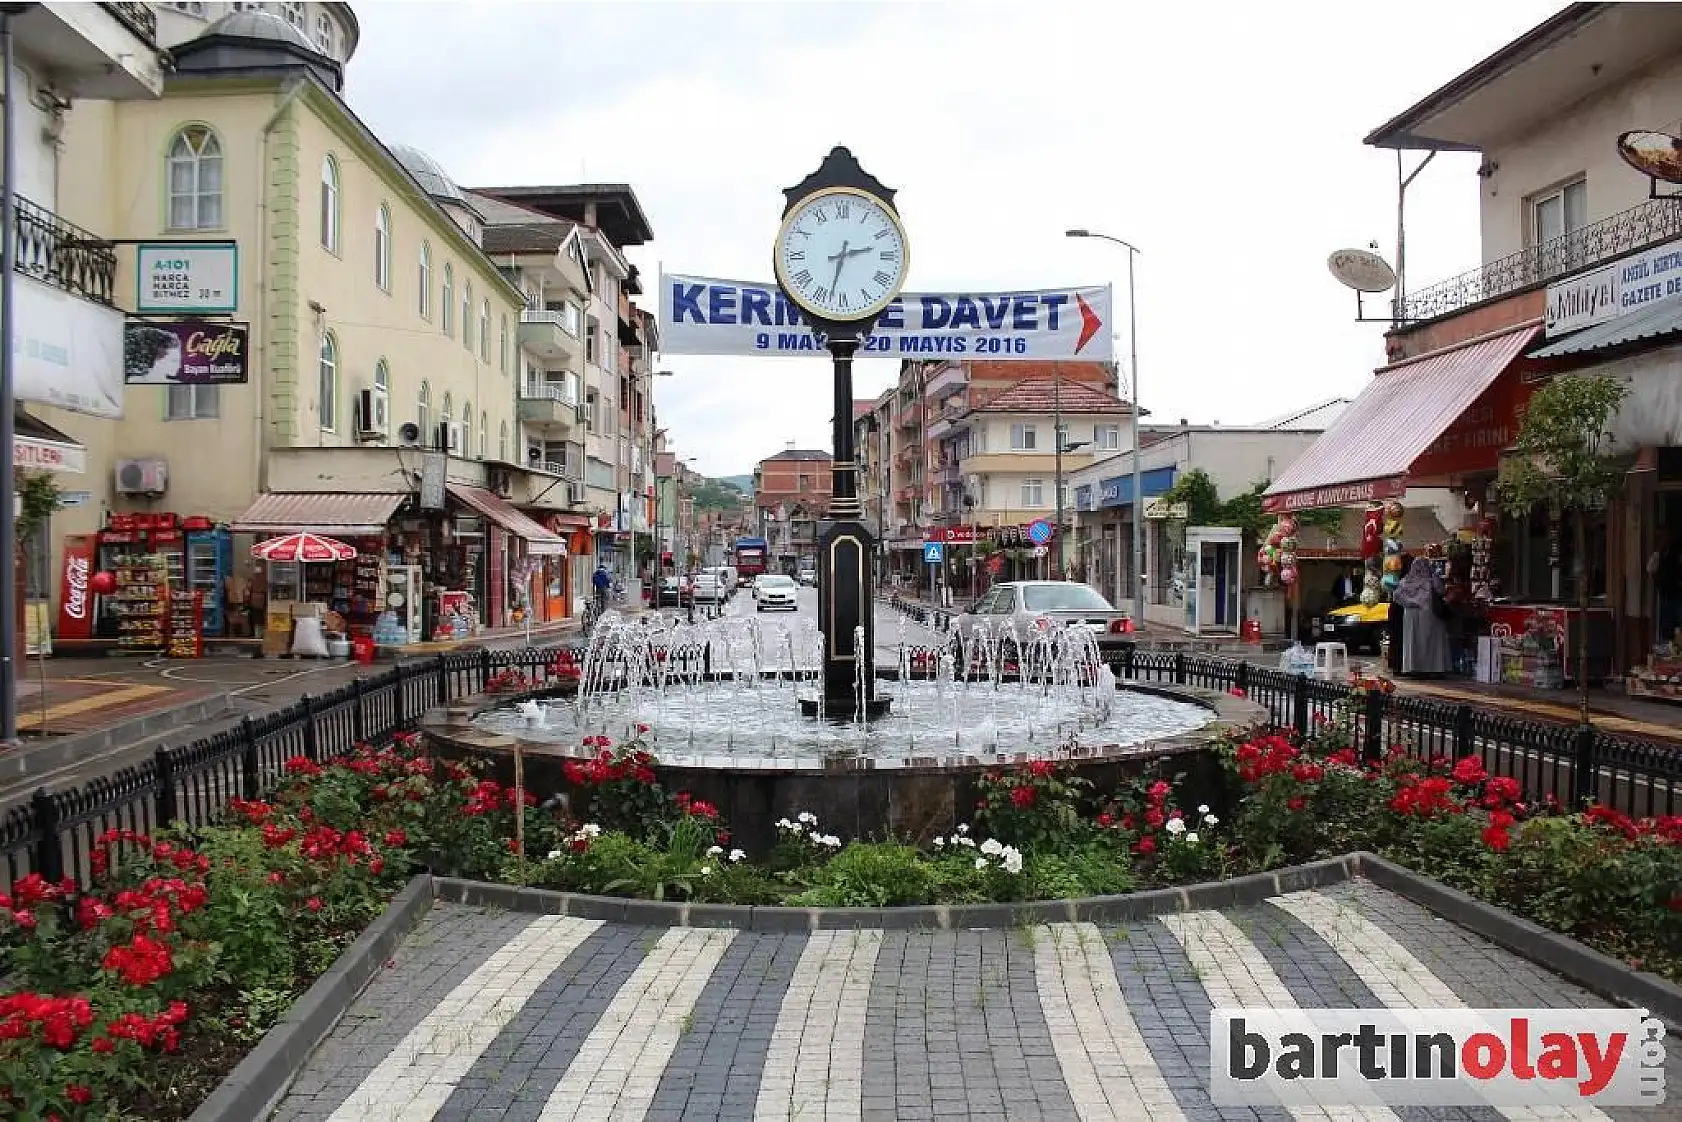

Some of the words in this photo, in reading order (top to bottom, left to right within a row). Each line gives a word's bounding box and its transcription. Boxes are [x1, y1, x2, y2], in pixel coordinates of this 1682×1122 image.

[836, 200, 850, 219] XII
[880, 250, 895, 261] III
[1622, 283, 1662, 308] GAZETE
[673, 284, 904, 330] KERME
[921, 294, 1069, 330] DAVET
[757, 333, 770, 350] 9
[778, 334, 826, 351] MAY
[864, 335, 892, 351] 20
[900, 336, 967, 353] MAYIS
[975, 337, 1027, 354] 2016
